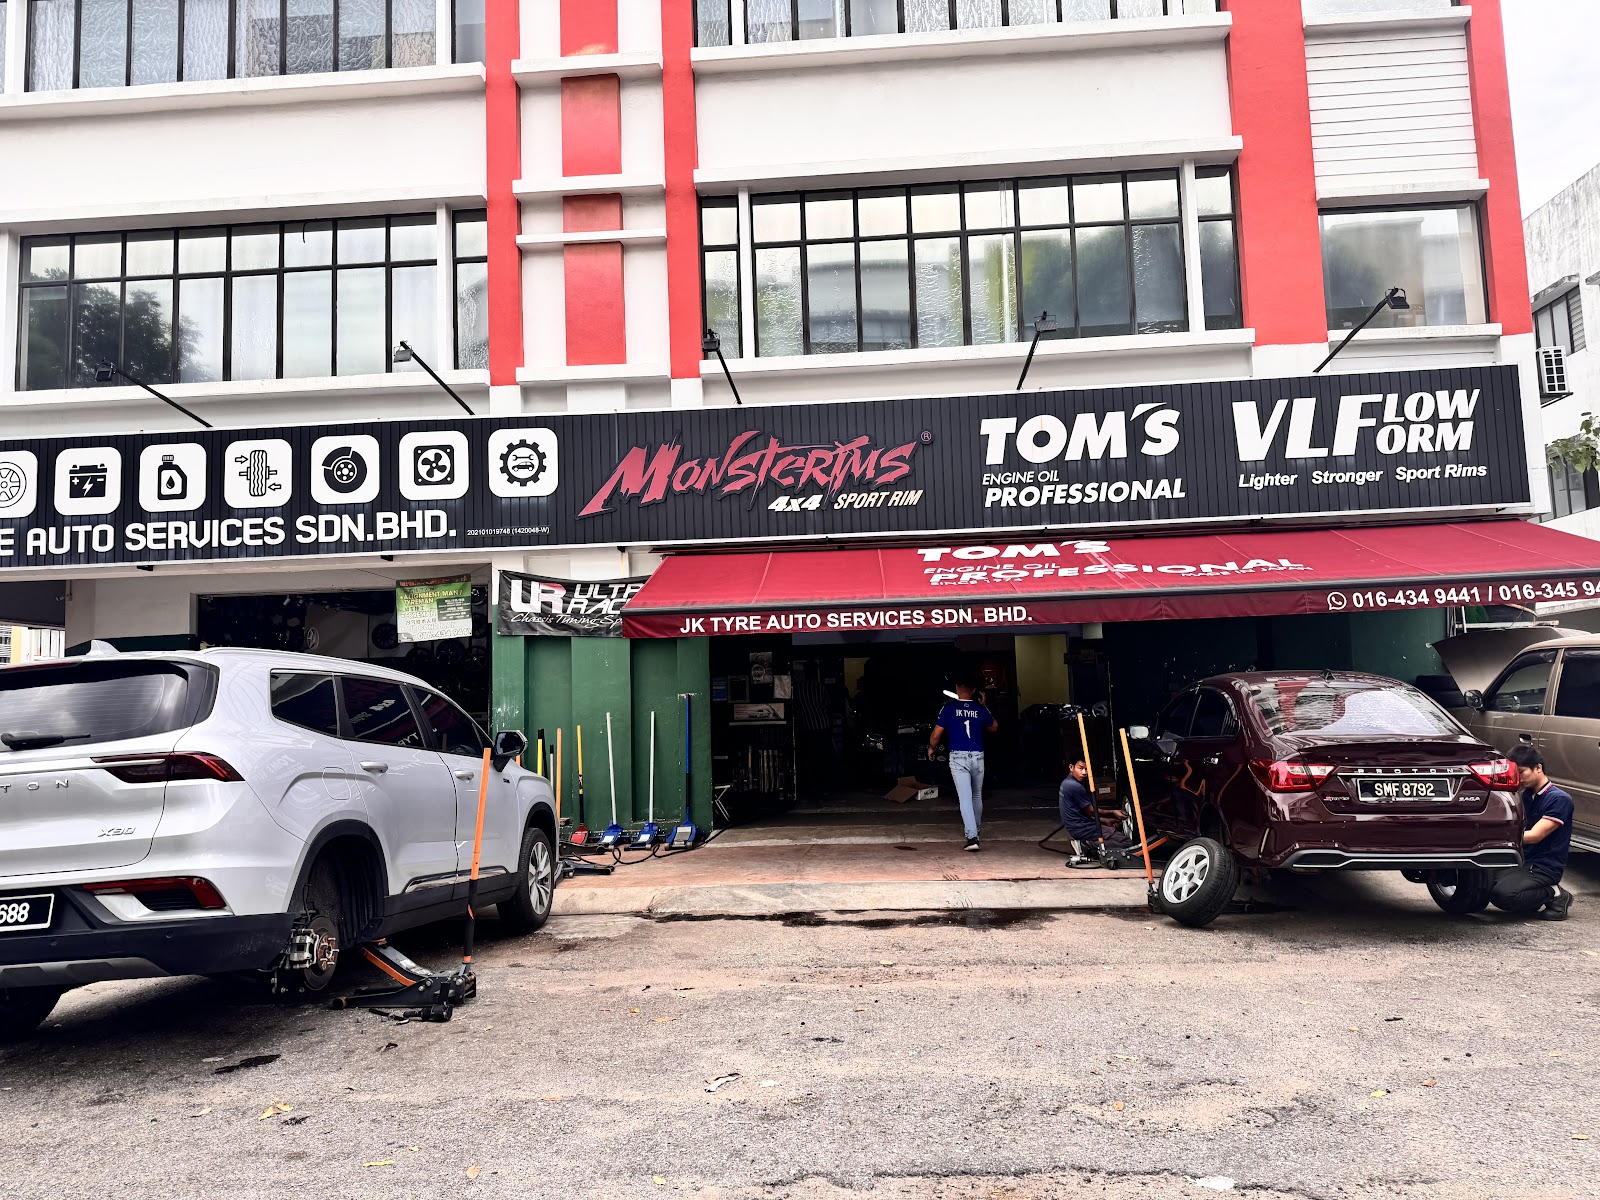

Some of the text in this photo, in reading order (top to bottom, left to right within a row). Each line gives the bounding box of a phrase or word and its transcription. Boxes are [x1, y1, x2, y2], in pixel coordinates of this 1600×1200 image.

[980, 402, 1181, 466] TOM'S
[982, 470, 1060, 485] ENGINE OIL
[1238, 463, 1488, 490] Lighter Stronger Sport Rims
[767, 489, 923, 512] 4x4 SPORT RIM
[984, 478, 1186, 508] PROFESSIONAL
[26, 524, 115, 556] AUTO
[125, 516, 286, 551] SERVICES
[295, 509, 457, 544] SDN.BHD.
[466, 528, 511, 536] 202101019748
[917, 540, 1111, 562] TOM'S
[923, 563, 1015, 574] ENGINE
[930, 558, 1304, 583] PROFESSIONAL
[403, 591, 440, 600] ALIGNMENT
[403, 597, 434, 605] TYREMAN
[510, 579, 567, 614] UR
[1352, 589, 1430, 608] 016-434
[1434, 586, 1481, 605] 9441
[1499, 581, 1579, 601] 016-345
[566, 598, 632, 615] RAC
[510, 612, 553, 623] Chassis
[556, 614, 600, 629] Tuning
[680, 605, 1033, 633] JK TYRE AUTO SERVICES SDN. BHD.
[956, 709, 978, 718] JK TYRE
[964, 720, 971, 738] 1
[1374, 782, 1436, 797] SMF 8792
[98, 826, 137, 838] X90
